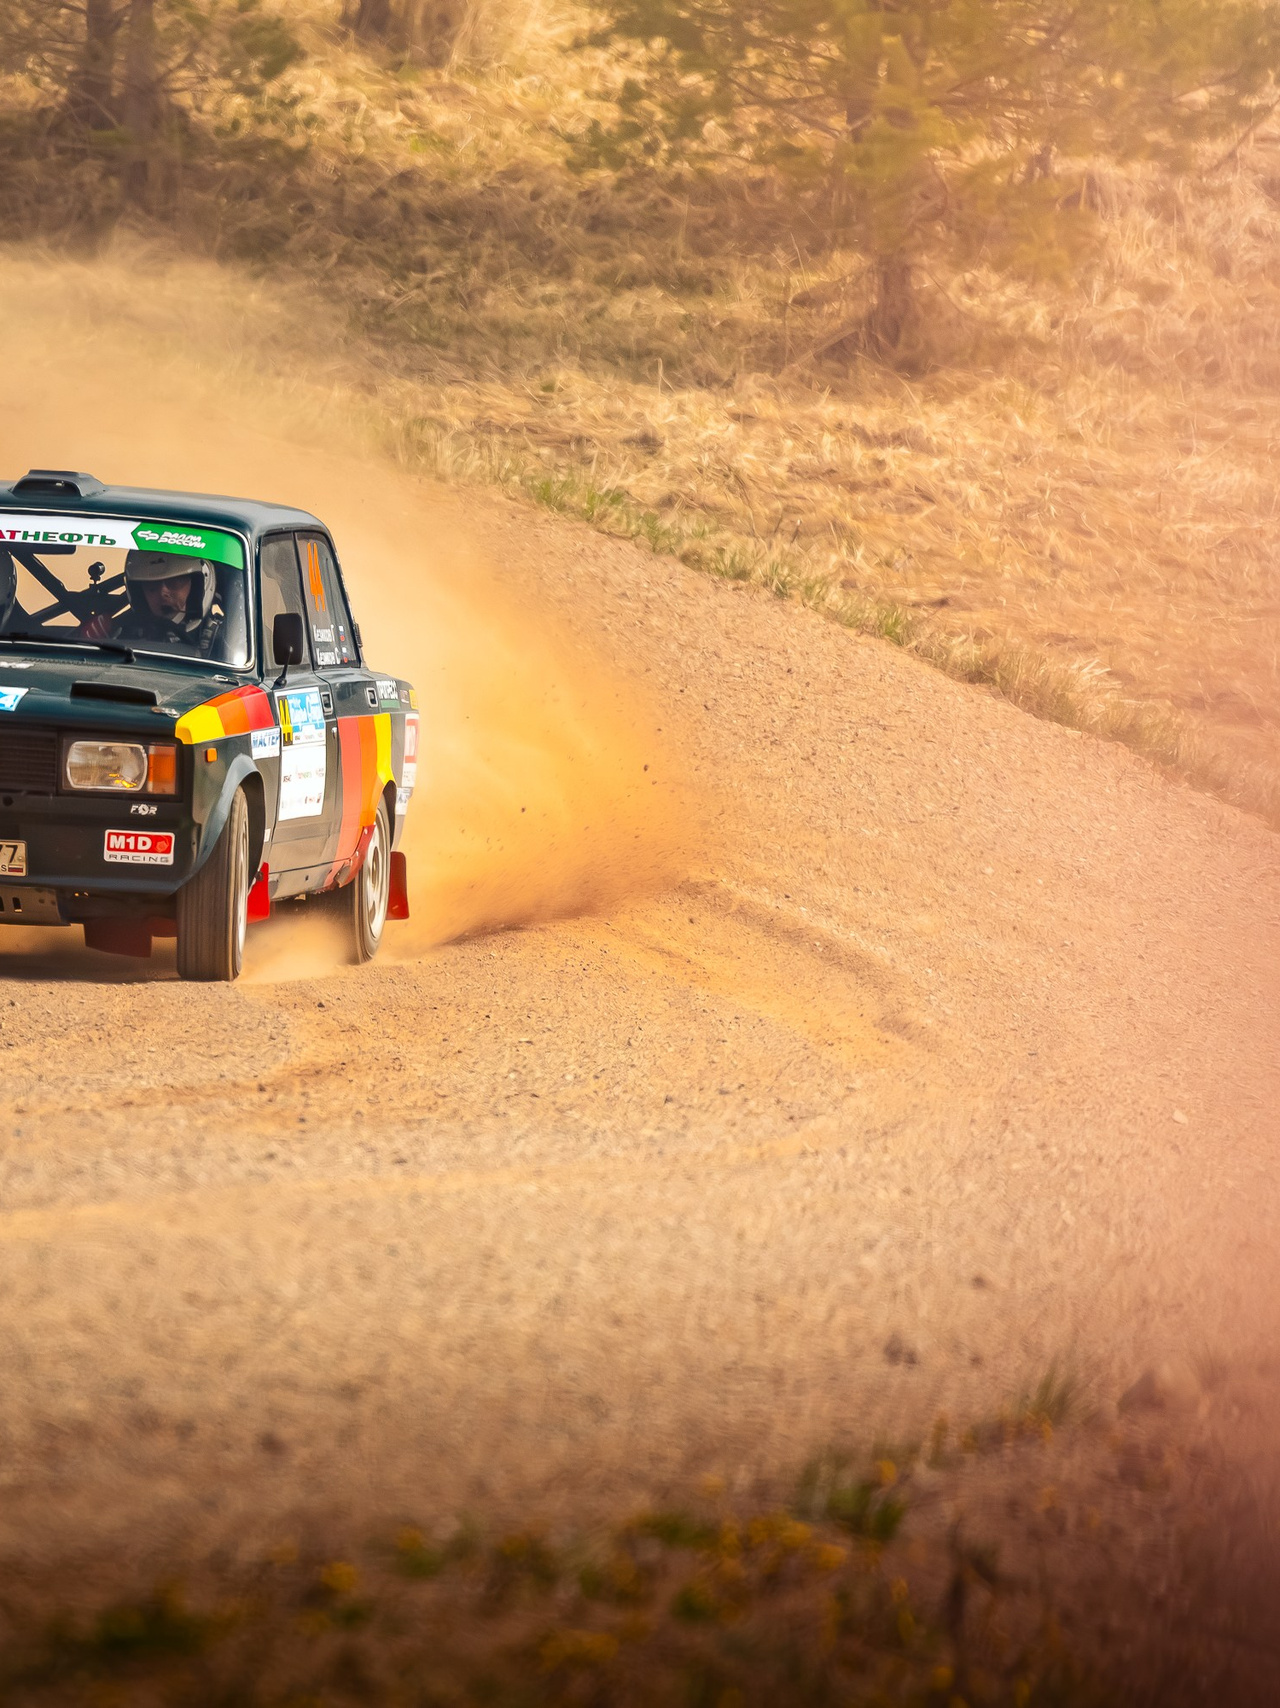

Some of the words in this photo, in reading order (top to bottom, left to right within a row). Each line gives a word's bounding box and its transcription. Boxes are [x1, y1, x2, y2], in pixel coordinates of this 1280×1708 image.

[307, 542, 326, 612] 44
[279, 698, 293, 742] 44
[109, 834, 152, 850] M1D
[108, 853, 169, 863] RACING
